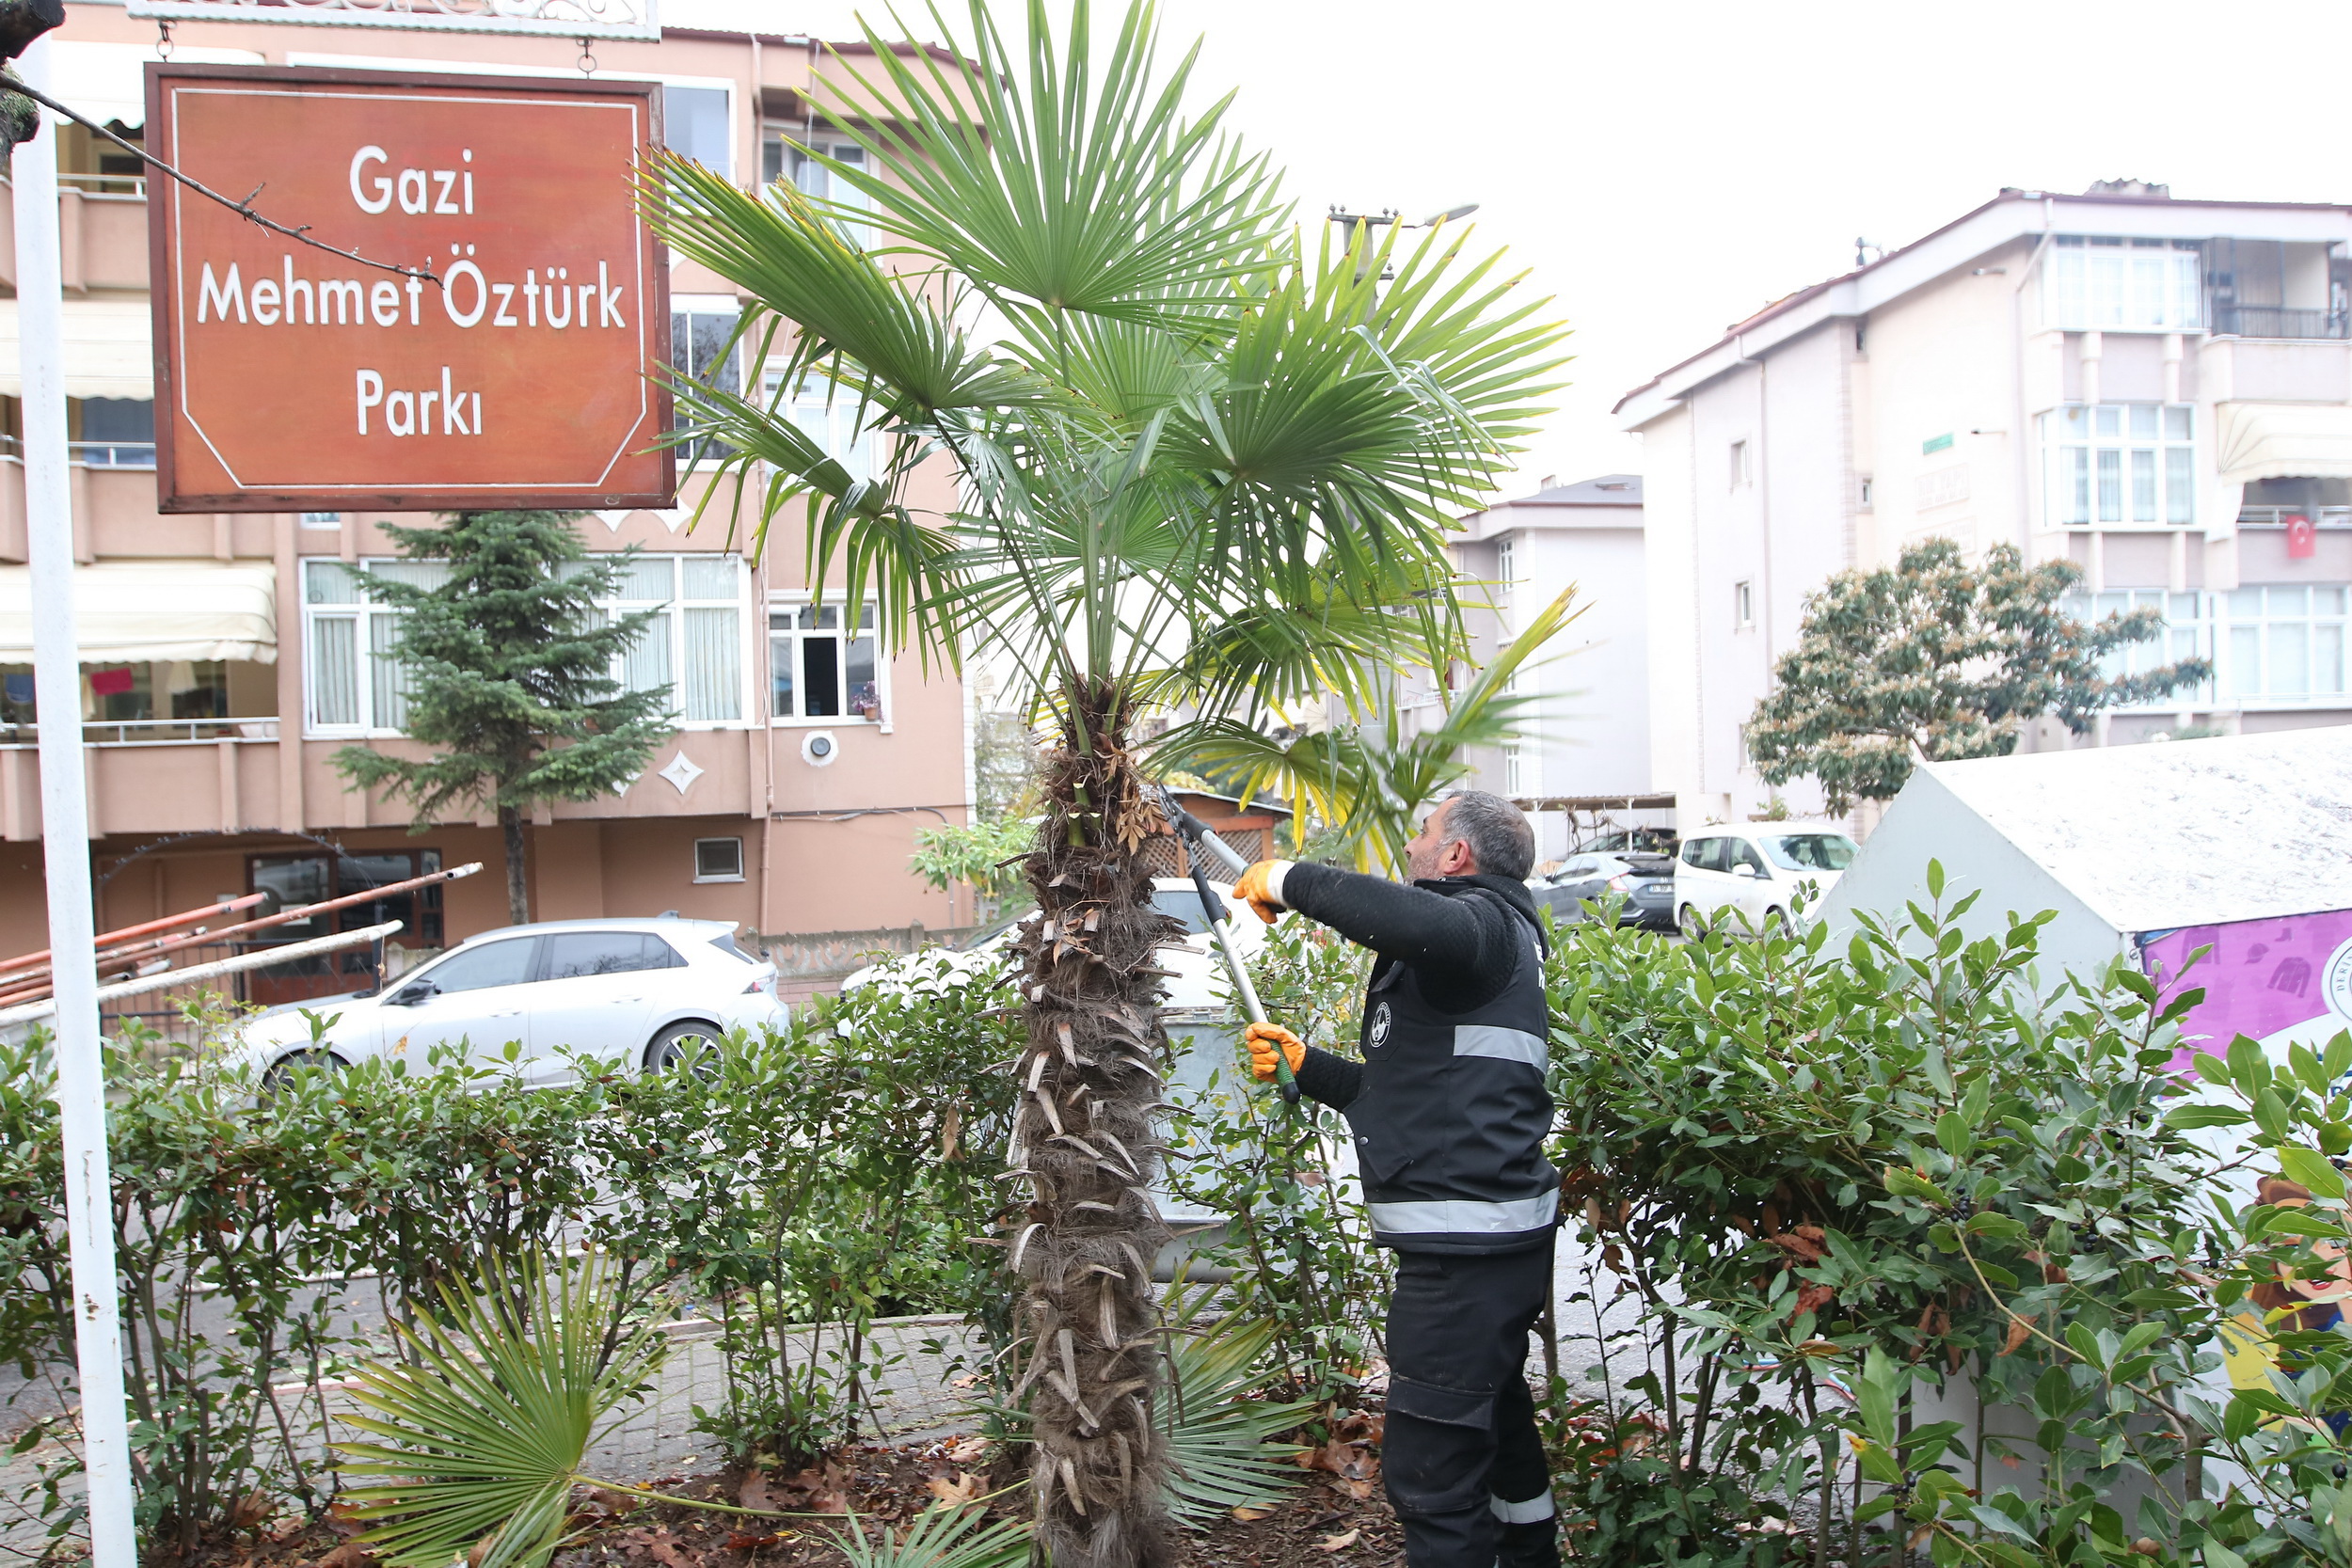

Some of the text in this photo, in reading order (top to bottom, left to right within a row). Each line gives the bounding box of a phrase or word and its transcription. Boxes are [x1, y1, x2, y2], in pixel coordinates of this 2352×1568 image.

[350, 145, 474, 215] Gazi
[197, 242, 627, 329] Mehmet Öztürk
[357, 366, 483, 436] Parkı
